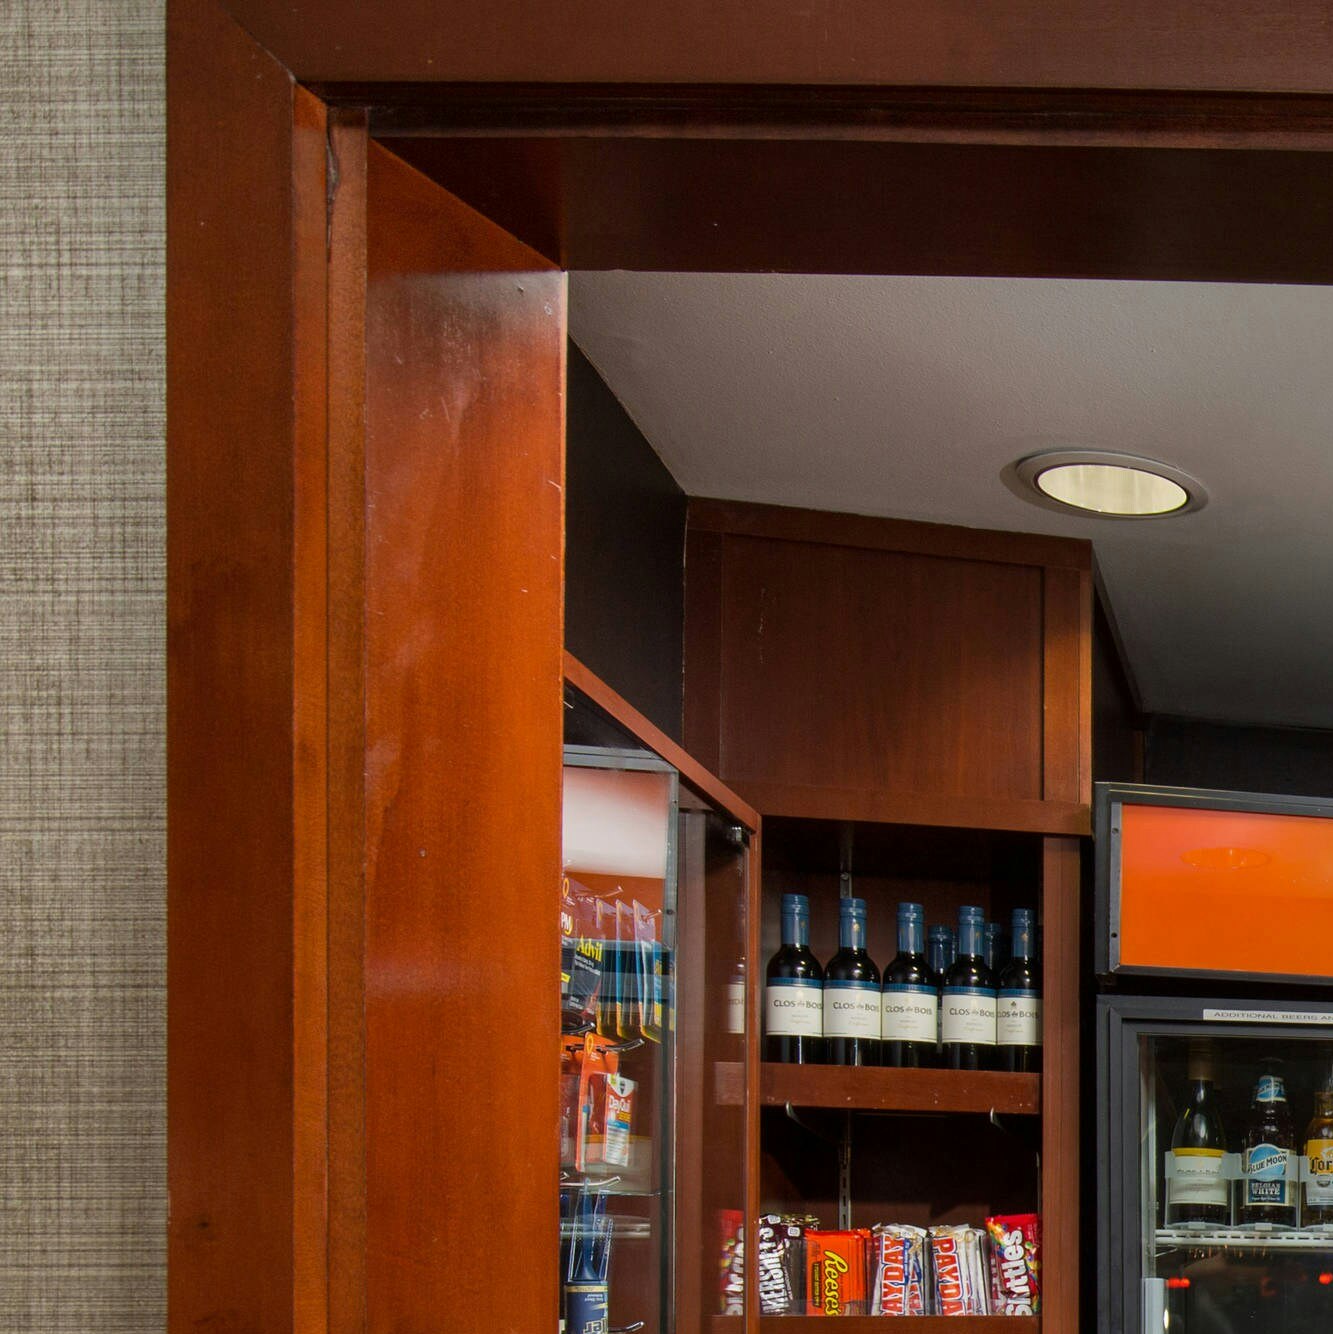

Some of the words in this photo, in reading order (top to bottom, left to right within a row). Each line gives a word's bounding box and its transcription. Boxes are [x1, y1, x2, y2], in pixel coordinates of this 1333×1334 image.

[577, 935, 603, 962] Advil
[774, 1000, 796, 1008] CLOS
[833, 1001, 855, 1010] CLOS
[885, 1005, 905, 1013] CLOS
[914, 1007, 932, 1015] BOIS
[949, 1008, 970, 1016] CLOS
[1214, 1011, 1278, 1019] ADDITIONAL
[1266, 1152, 1287, 1166] MOON
[882, 1233, 905, 1316] AYDAY
[933, 1237, 966, 1315] PAYDA
[1001, 1230, 1033, 1315] Skittles
